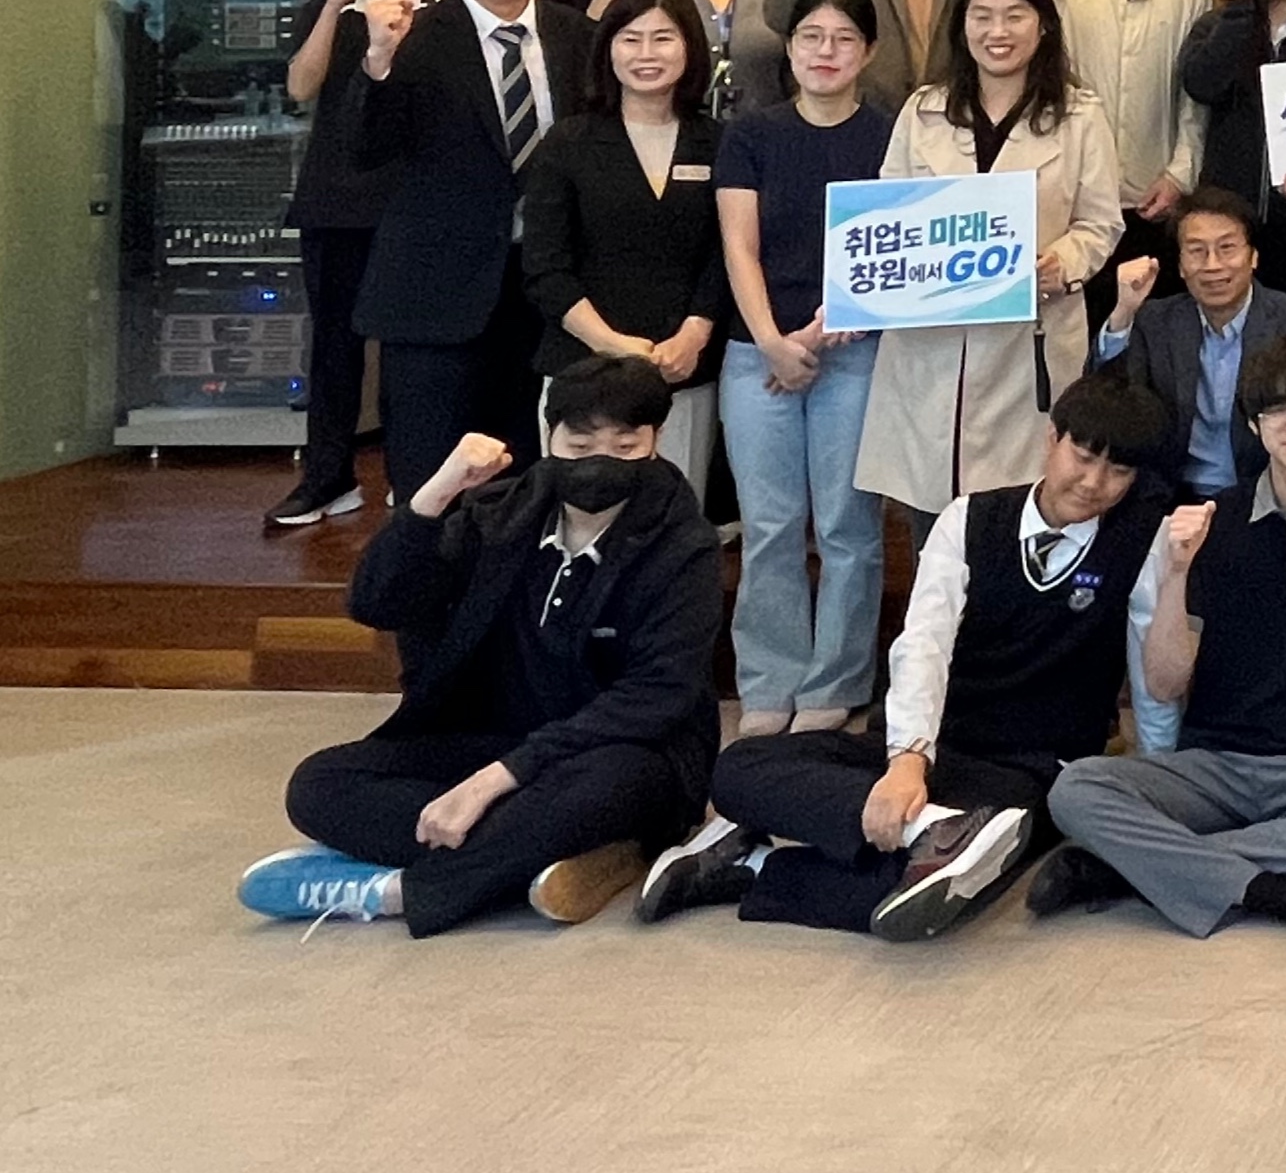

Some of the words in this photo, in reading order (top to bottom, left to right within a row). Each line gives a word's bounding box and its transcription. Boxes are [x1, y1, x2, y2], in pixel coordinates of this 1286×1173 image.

[844, 220, 923, 259] 취업도
[928, 210, 1016, 247] 미래도,
[848, 257, 943, 295] 창원에서
[946, 243, 1024, 283] GO!
